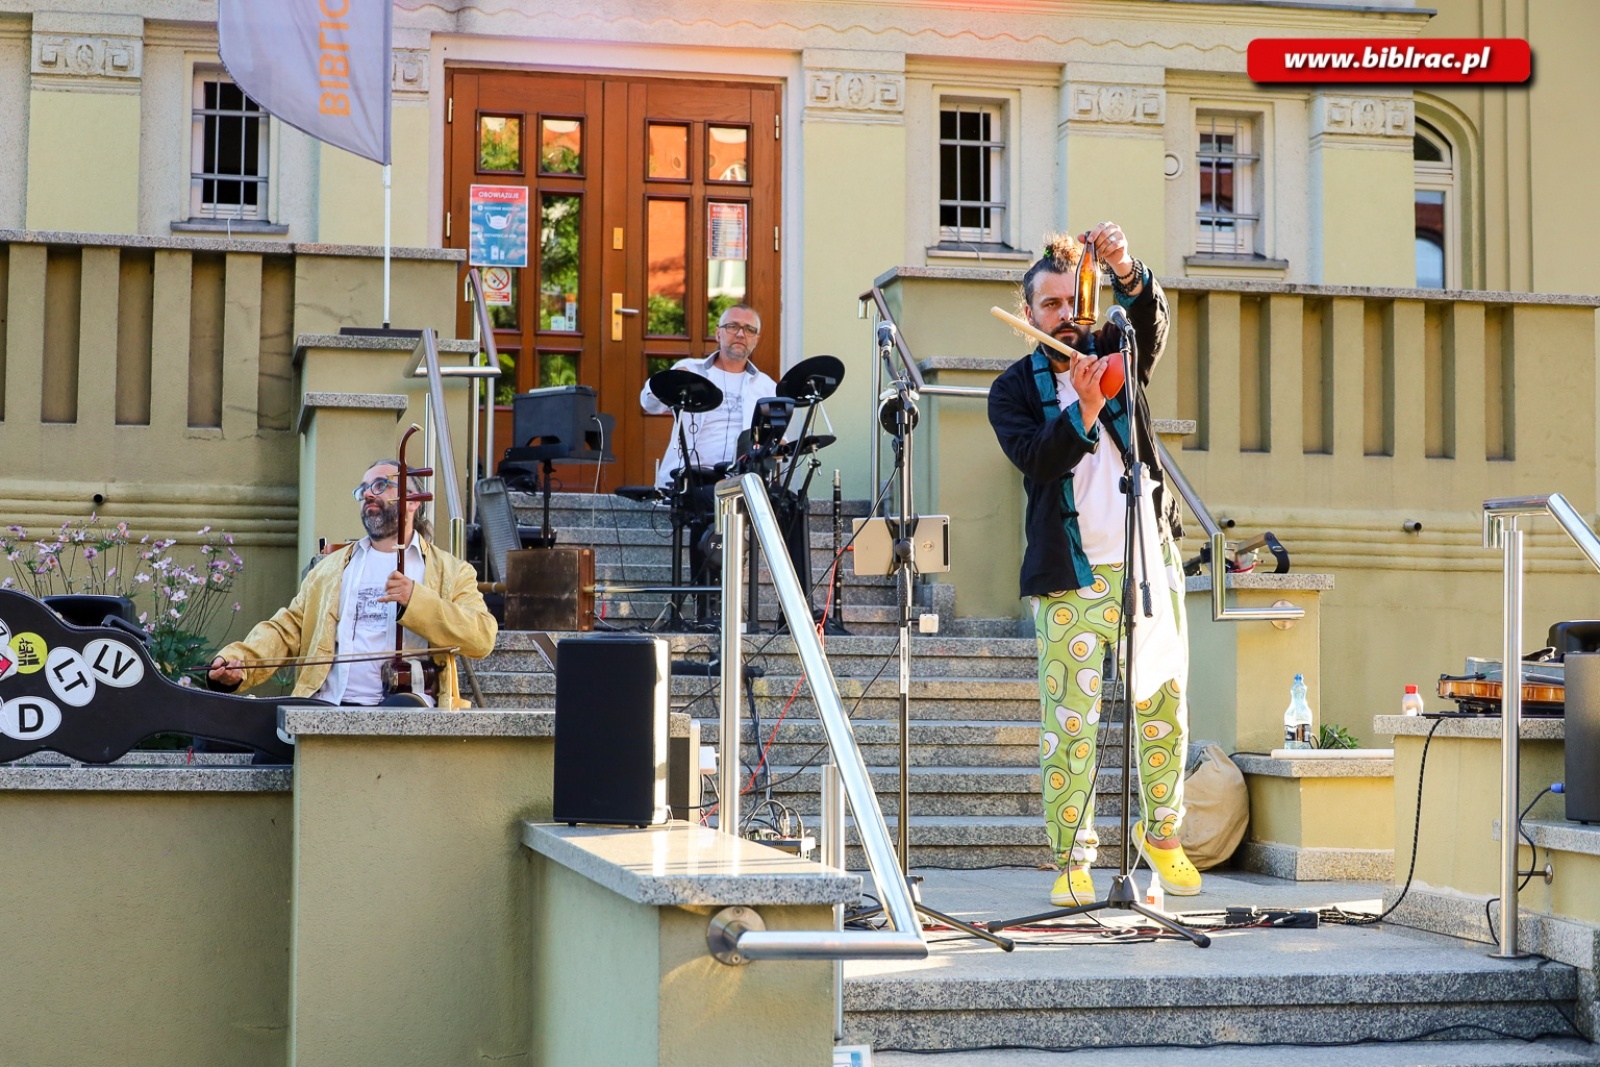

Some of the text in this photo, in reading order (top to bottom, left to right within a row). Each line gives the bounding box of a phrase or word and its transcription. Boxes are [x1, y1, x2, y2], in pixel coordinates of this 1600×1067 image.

[478, 191, 520, 200] OBOWIĄZUJE
[52, 657, 90, 692] LT
[92, 643, 136, 680] LV
[18, 703, 44, 733] D
